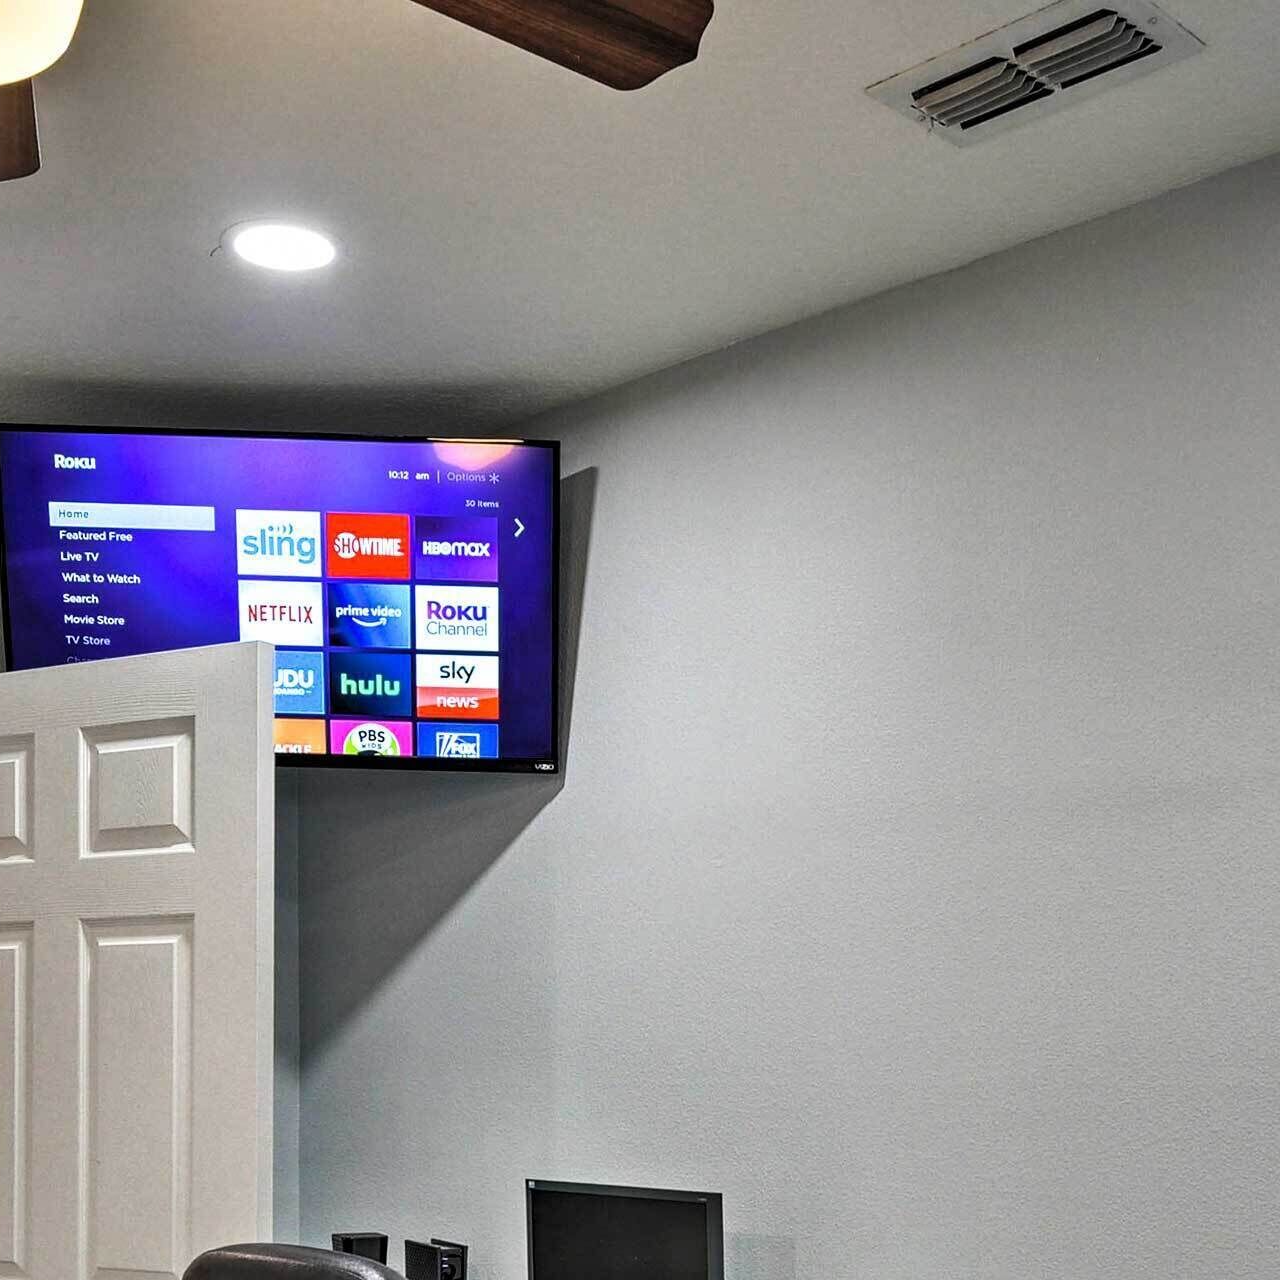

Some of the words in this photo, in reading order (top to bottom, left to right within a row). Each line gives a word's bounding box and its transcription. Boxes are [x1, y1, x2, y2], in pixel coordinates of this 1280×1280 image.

[53, 454, 96, 469] Roku
[415, 472, 430, 480] am
[447, 472, 486, 482] Options
[58, 508, 89, 519] Home
[59, 530, 107, 541] Featured
[108, 531, 133, 542] Free
[242, 524, 316, 565] sling
[333, 532, 405, 559] SHOWTIME
[60, 551, 82, 562] Live
[84, 552, 100, 562] TV
[61, 572, 90, 583] What
[93, 574, 105, 583] to
[106, 573, 141, 584] Watch
[63, 593, 100, 604] Search
[248, 603, 313, 625] NETFLIX
[336, 604, 369, 618] prime
[371, 606, 402, 618] video
[427, 600, 487, 621] Roku
[64, 614, 95, 625] Movie
[97, 615, 125, 626] Store
[426, 621, 487, 637] Channel
[65, 635, 80, 645] TV
[82, 635, 111, 646] Store
[439, 660, 475, 683] sky
[340, 674, 400, 696] hulu
[436, 694, 479, 708] news
[358, 729, 386, 743] PBS
